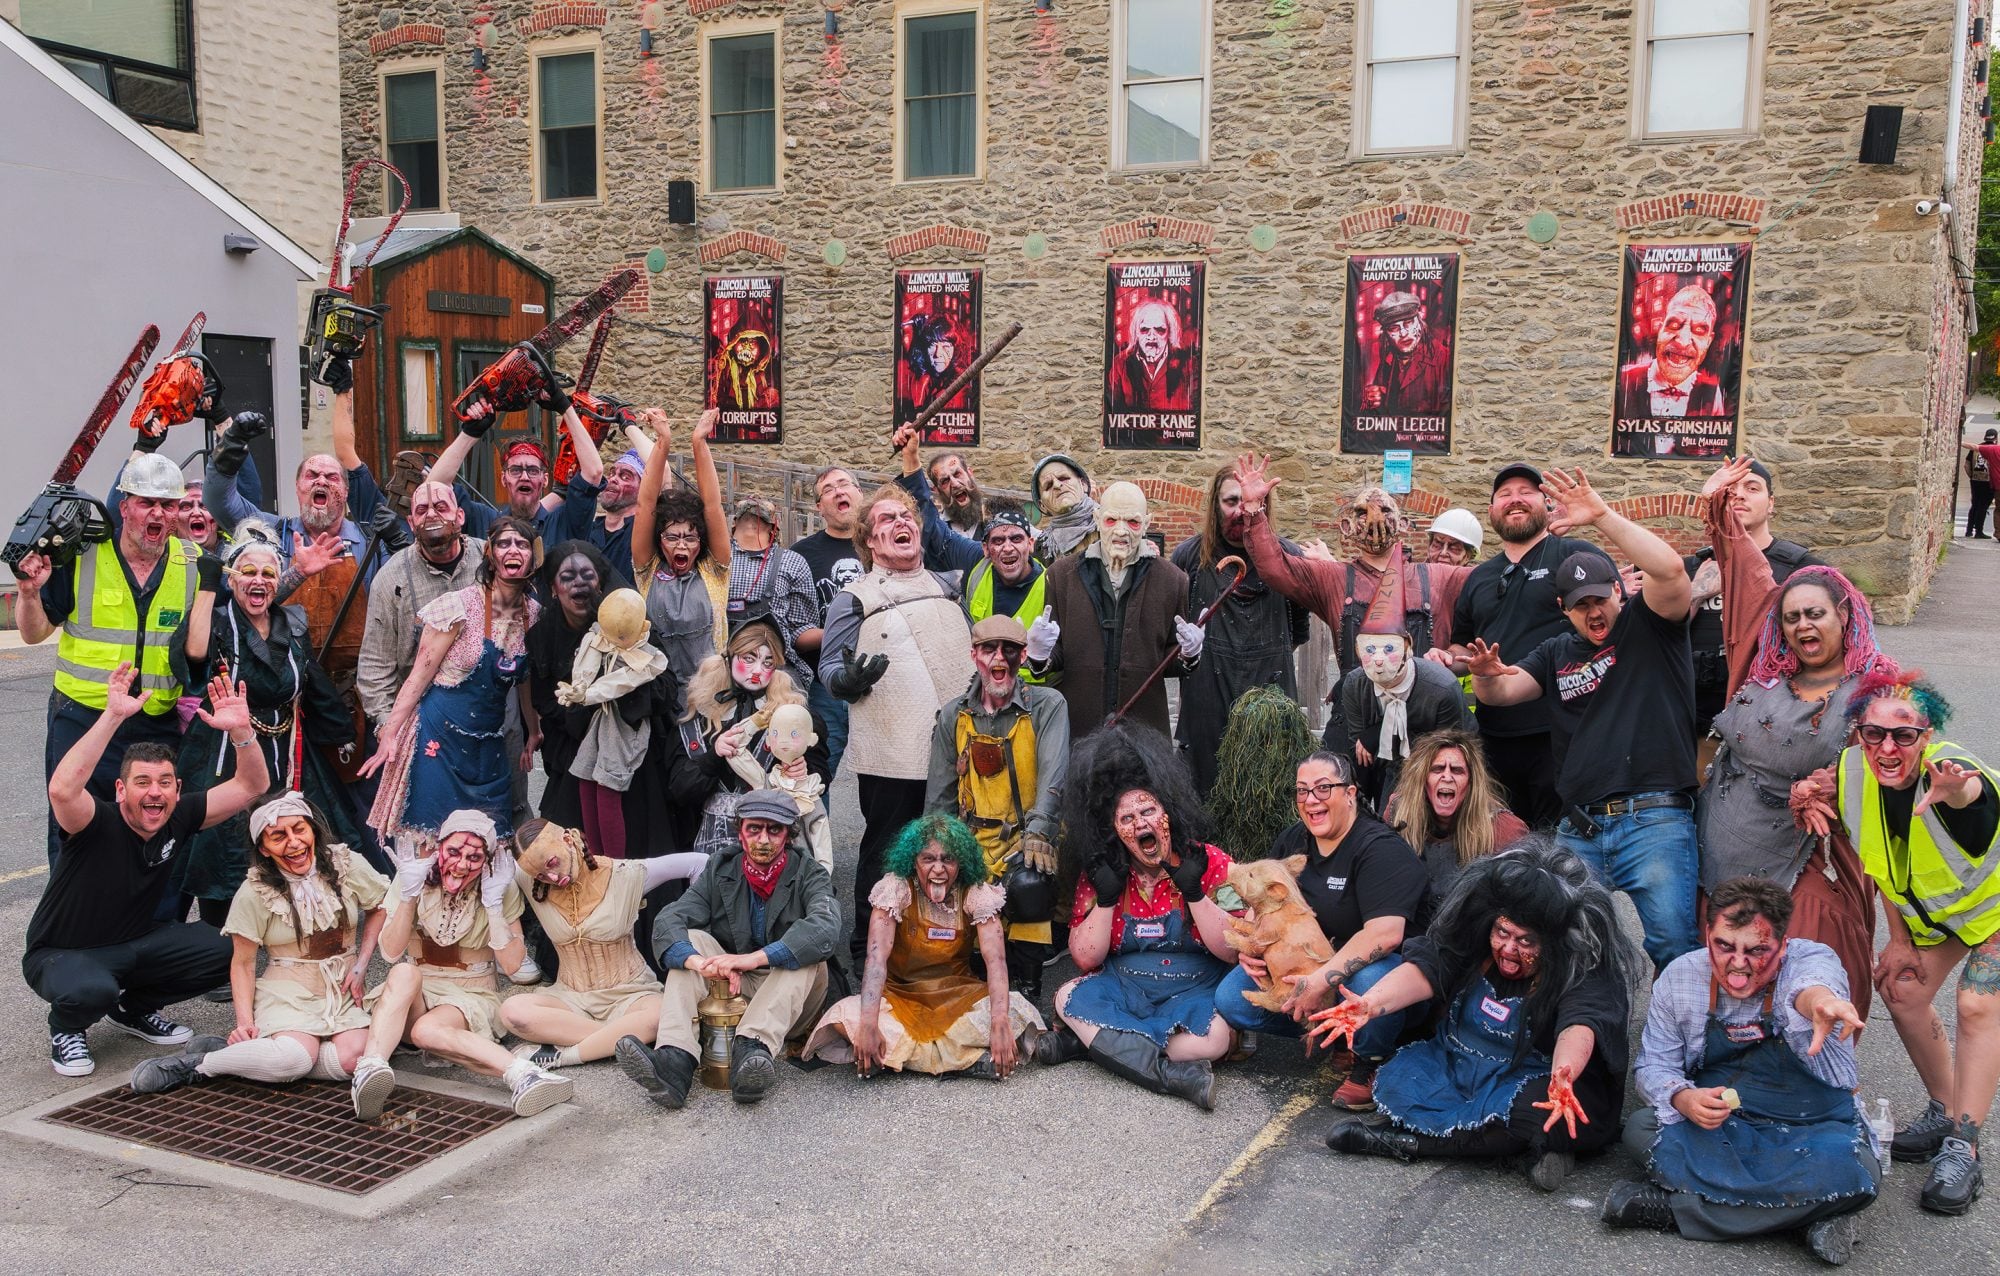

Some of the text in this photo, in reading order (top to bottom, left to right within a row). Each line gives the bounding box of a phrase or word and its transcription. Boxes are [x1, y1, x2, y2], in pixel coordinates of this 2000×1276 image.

[1643, 247, 1732, 262] LINCOLN MILL
[1364, 257, 1442, 271] LINCOLN MILL
[1641, 262, 1733, 273] HAUNTED HOUSE
[908, 271, 969, 284] LINCOLN MILL
[1121, 264, 1191, 278] LINCOLN MILL
[1362, 270, 1442, 281] HAUNTED HOUSE
[716, 278, 771, 290] LINCOLN MILL
[907, 284, 969, 293] HAUNTED HOUSE
[1120, 277, 1191, 287] HAUNTED HOUSE
[749, 290, 771, 298] HOUSE
[440, 294, 477, 312] LINCOLN
[722, 411, 777, 424] CORRUPTIS
[1108, 413, 1196, 428] VIKTOR KANE
[1357, 417, 1445, 431] EDWIN LEECH
[1617, 419, 1732, 435] SYLAS GRIMSHAW
[1396, 432, 1445, 442] NIGHT WATCHMAN
[1681, 436, 1728, 447] MILL MANAGER
